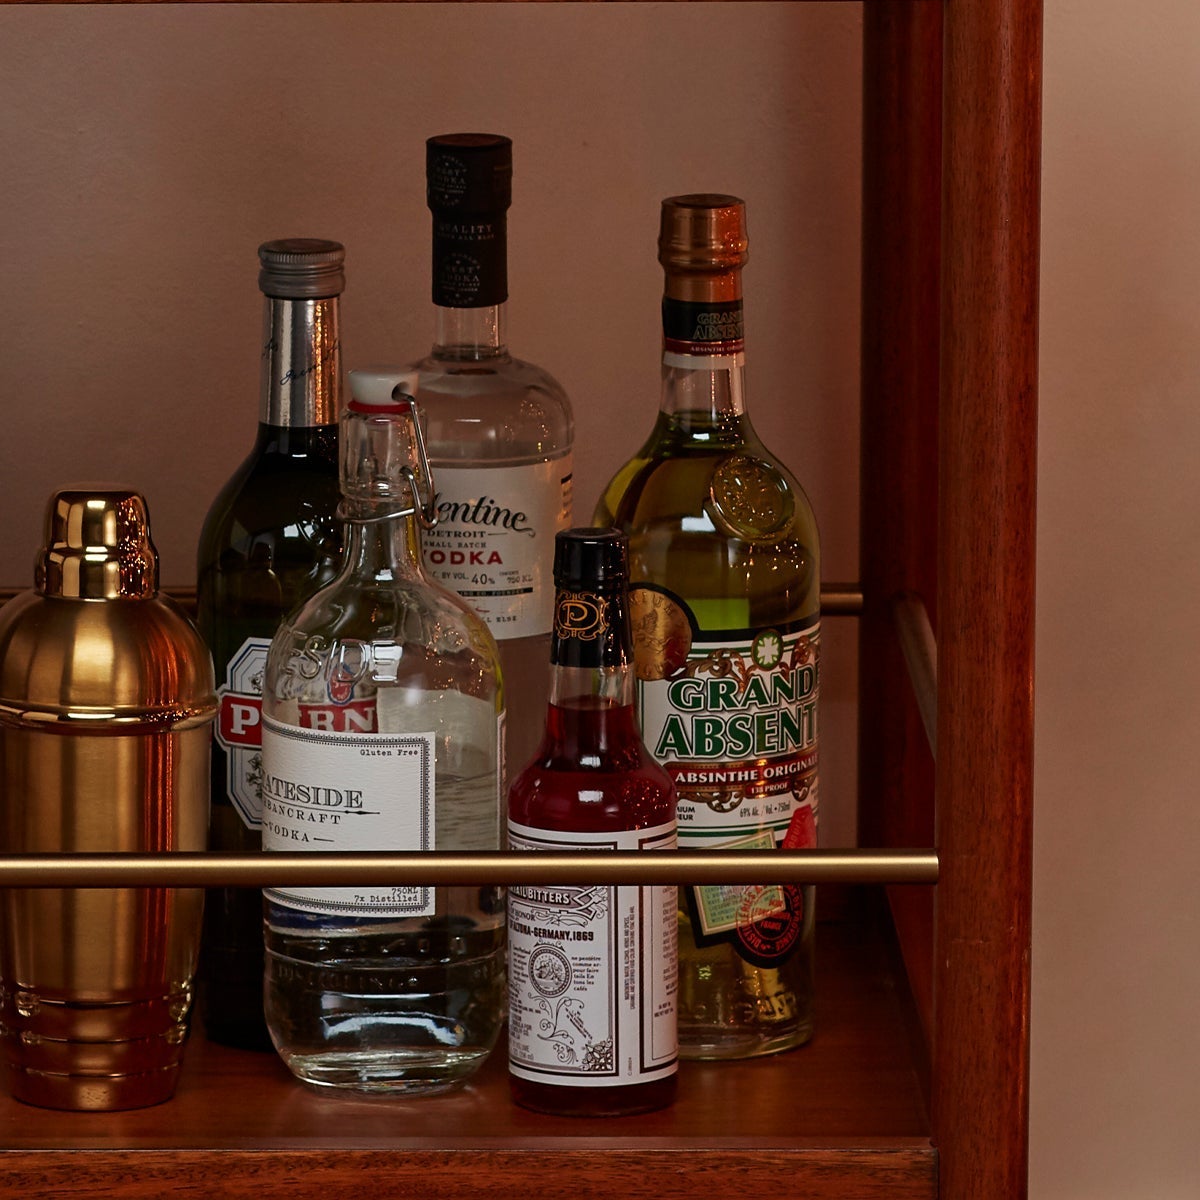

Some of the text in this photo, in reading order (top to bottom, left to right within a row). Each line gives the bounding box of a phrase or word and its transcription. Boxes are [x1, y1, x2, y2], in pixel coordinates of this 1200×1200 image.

[426, 530, 487, 538] DETROIT
[424, 550, 503, 566] ODKA
[360, 748, 419, 757] Gluten Free
[675, 769, 758, 784] ABSINTHE
[764, 783, 788, 793] PROOF
[268, 823, 310, 843] VODKA
[370, 893, 419, 904] Distilled
[528, 889, 571, 905] BITTERS
